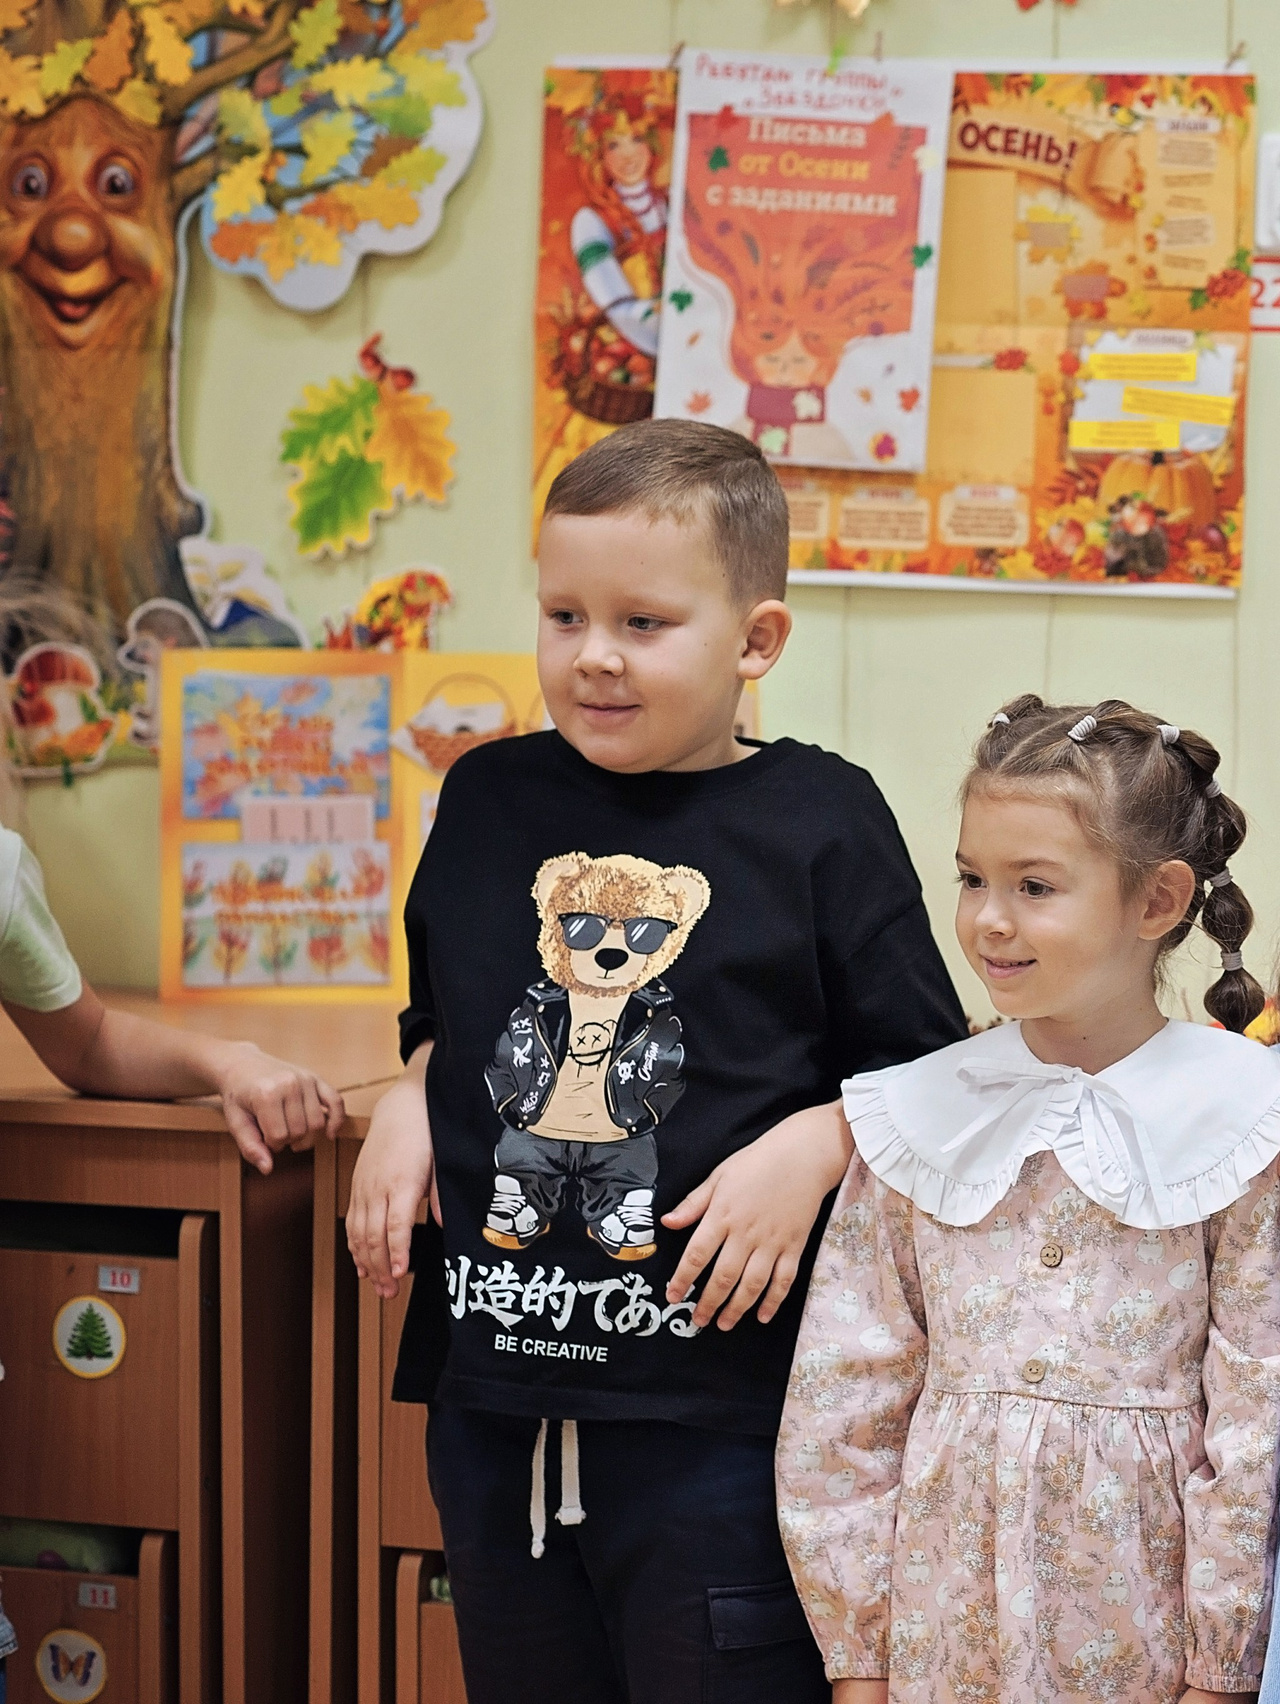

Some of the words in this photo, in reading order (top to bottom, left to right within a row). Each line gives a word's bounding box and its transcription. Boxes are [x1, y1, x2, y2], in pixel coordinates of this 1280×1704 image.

[748, 117, 867, 149] Письма
[959, 121, 1077, 170] ОСЕНЬ!
[738, 154, 773, 176] от
[779, 151, 871, 182] Осени
[706, 185, 725, 206] с
[729, 187, 897, 217] заданиями
[111, 1271, 131, 1288] 10
[494, 1333, 518, 1353] BE
[521, 1338, 609, 1362] CREATIVE
[91, 1589, 109, 1606] 11
